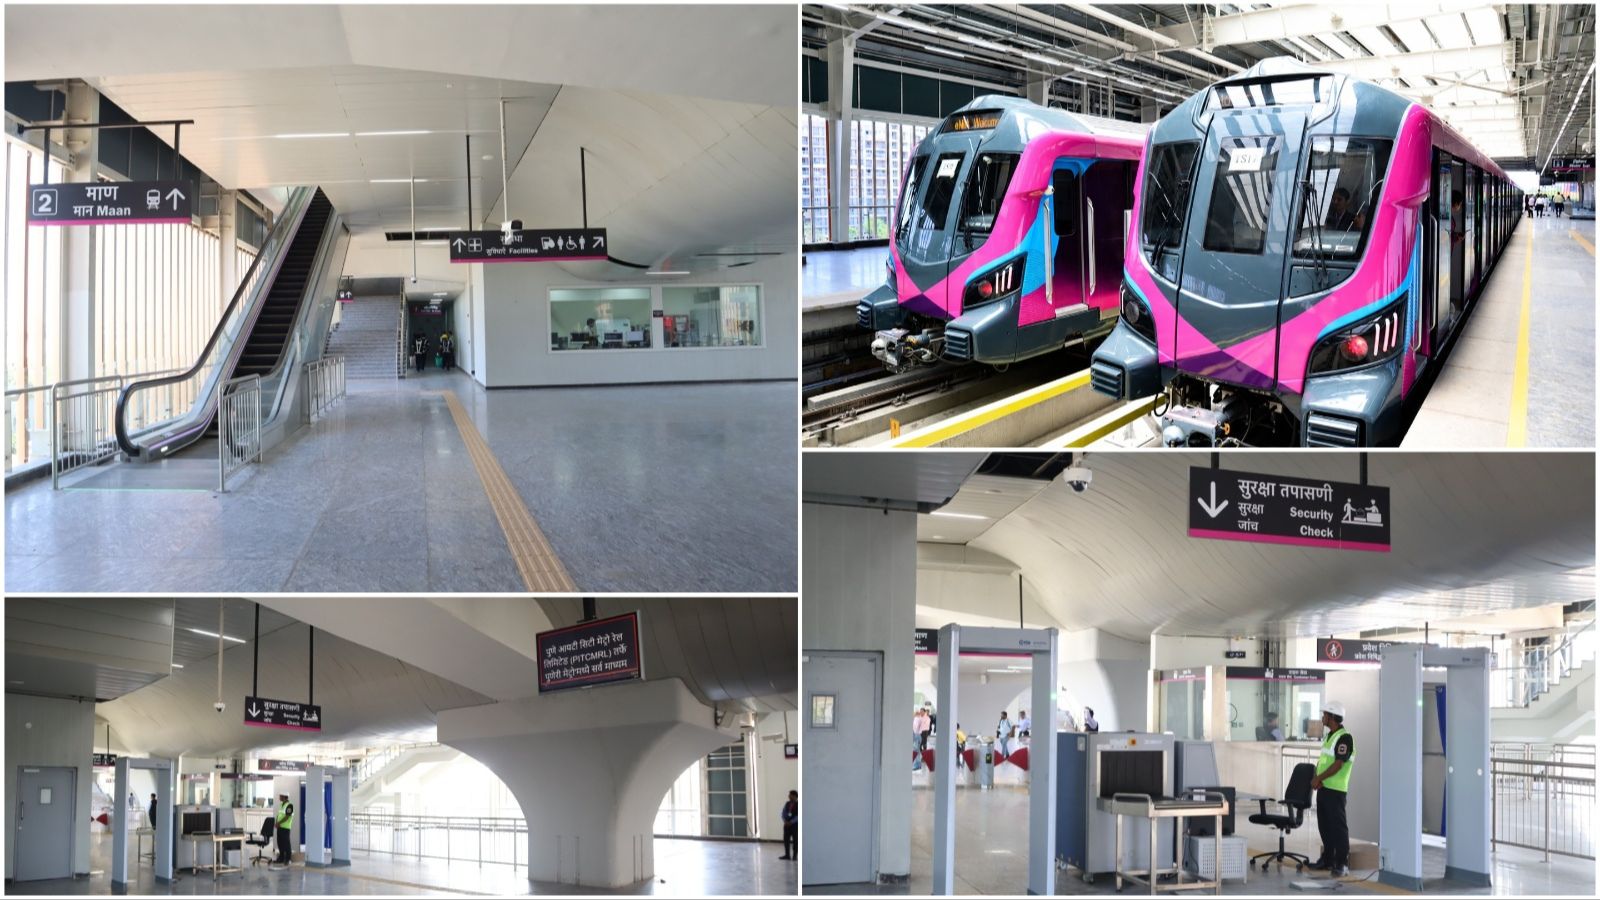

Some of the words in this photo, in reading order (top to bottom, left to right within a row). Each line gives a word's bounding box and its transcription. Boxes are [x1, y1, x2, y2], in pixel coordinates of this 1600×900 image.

[85, 185, 119, 201] माण
[38, 193, 52, 213] 2
[73, 205, 94, 217] मान
[96, 205, 131, 217] Maan
[509, 247, 538, 255] Facilities
[1237, 479, 1276, 500] सुरक्षा
[1280, 483, 1334, 502] तपासणी
[1237, 502, 1264, 516] सुरक्षा
[1290, 506, 1334, 523] Security
[1237, 519, 1259, 532] जांच
[1300, 525, 1334, 538] Check
[546, 645, 557, 658] पुणे
[611, 633, 623, 642] रेल
[570, 649, 612, 666] (PITCMRL)
